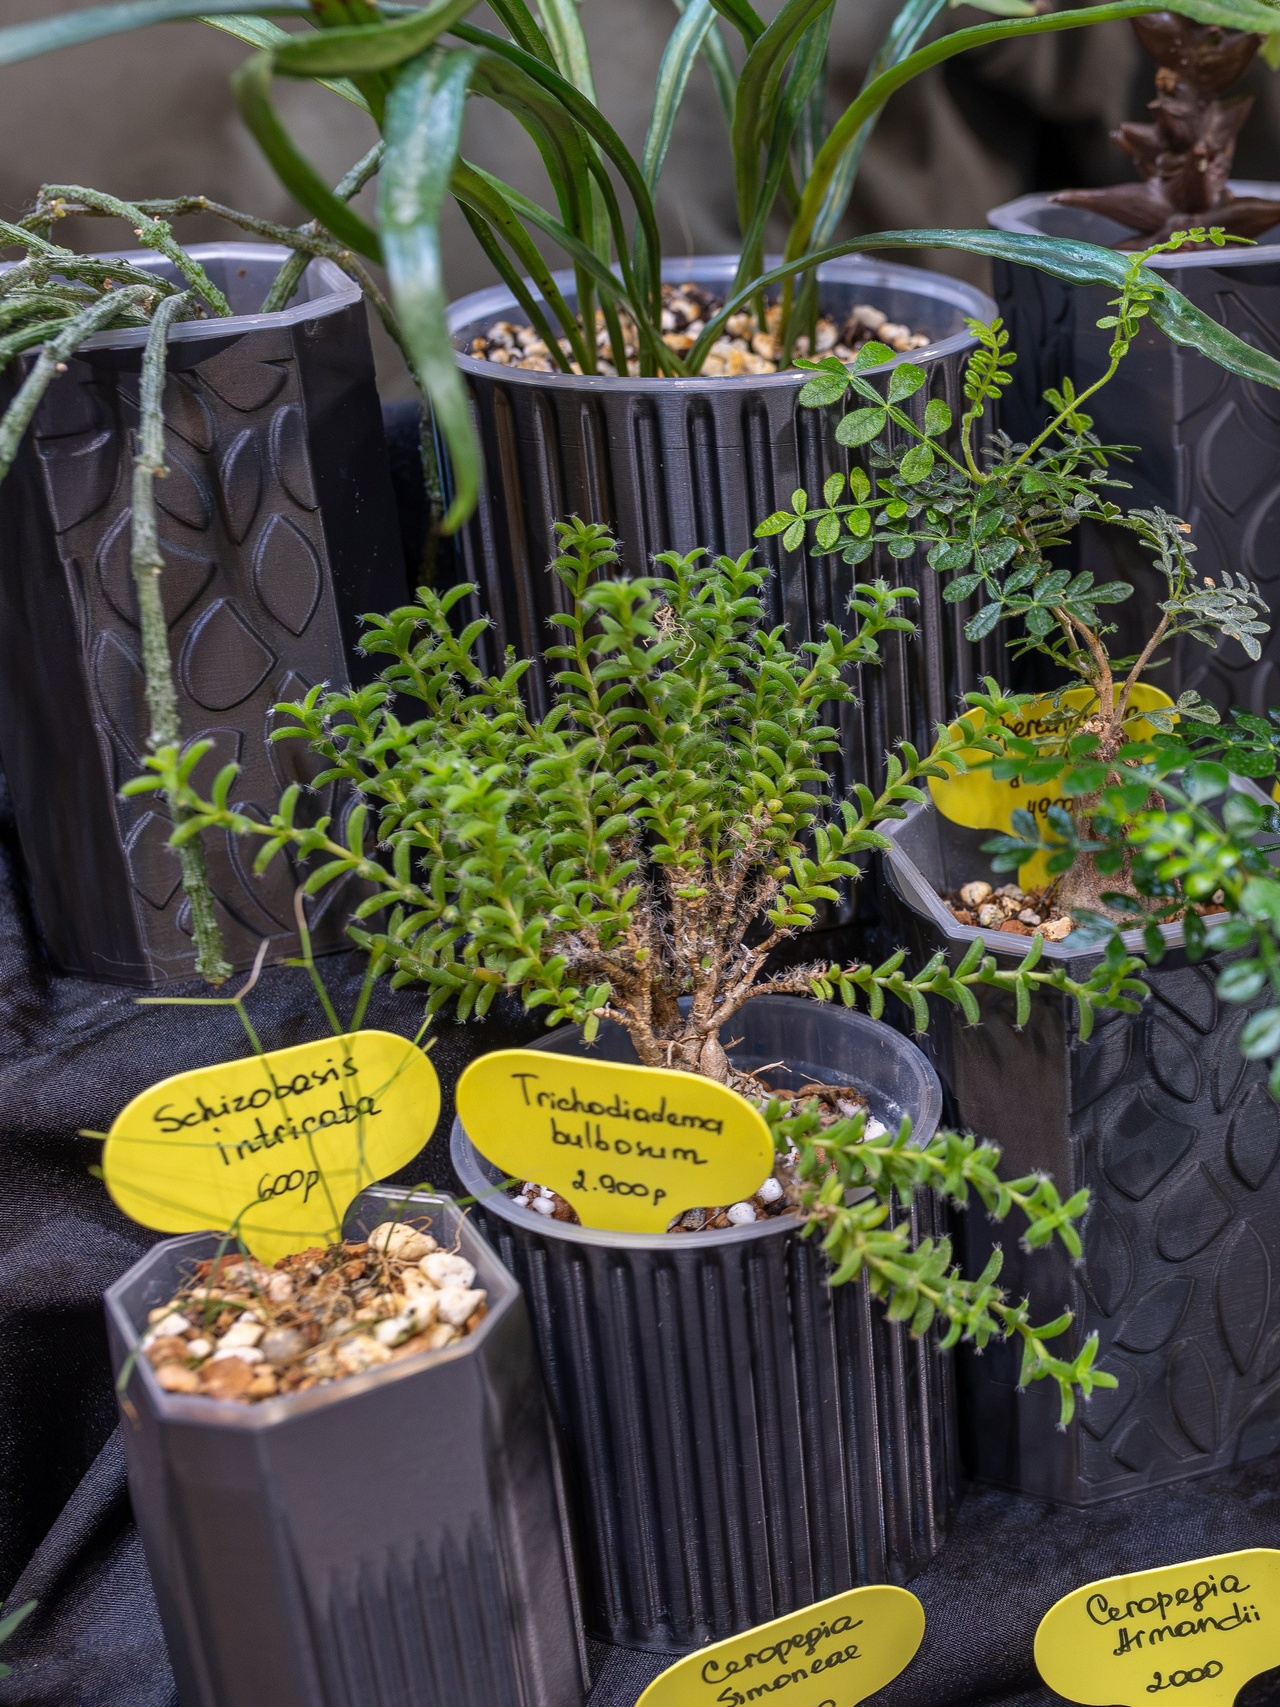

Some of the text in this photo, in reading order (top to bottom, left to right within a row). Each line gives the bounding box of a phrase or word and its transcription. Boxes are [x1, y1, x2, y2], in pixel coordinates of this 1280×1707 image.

[154, 1058, 359, 1133] Schizobasis
[510, 1073, 723, 1135] Trichodiadema
[213, 1091, 383, 1166] intricata
[551, 1117, 708, 1165] bulbosum
[1086, 1574, 1250, 1626] Ceropegia
[1112, 1602, 1261, 1656] Armandii
[701, 1615, 864, 1684] Ceropegia
[1145, 1660, 1224, 1693] 2000
